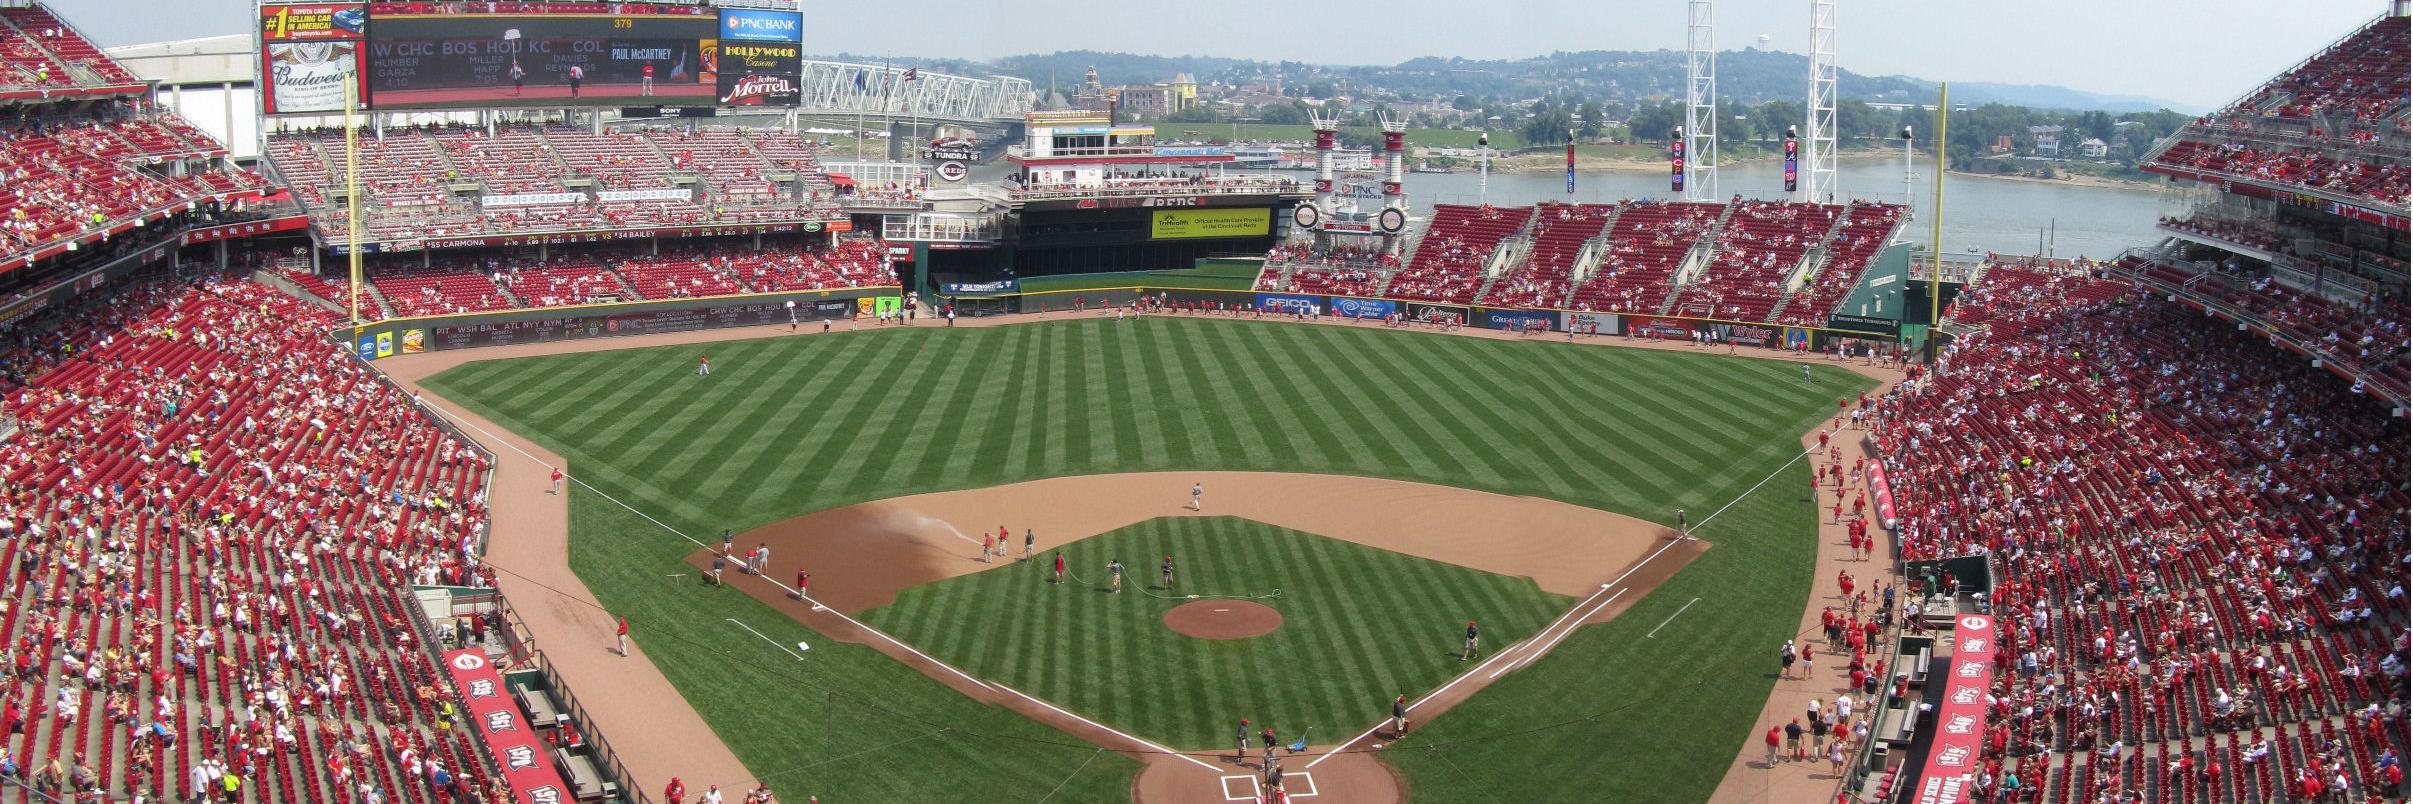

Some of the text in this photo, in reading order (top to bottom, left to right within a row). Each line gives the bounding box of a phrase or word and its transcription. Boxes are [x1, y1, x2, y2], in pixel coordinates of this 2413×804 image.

[265, 6, 288, 38] #1
[296, 22, 332, 30] AMERICA!
[614, 19, 632, 29] 379
[741, 18, 796, 30] PNC BANK
[397, 43, 434, 56] CHC
[442, 42, 478, 54] BOS
[486, 41, 522, 54] HOU
[529, 40, 550, 53] KC
[573, 40, 604, 53] COL
[725, 46, 796, 58] HOLLYWOOD
[553, 54, 589, 62] DAVIES
[612, 48, 672, 60] PAUL McCARTNEY
[374, 58, 419, 67] HUMBER
[469, 56, 504, 65] MILLER
[744, 56, 778, 67] Casino
[378, 68, 416, 77] GARZA
[474, 65, 500, 74] HAPP
[545, 63, 596, 72] REYNDS
[754, 75, 778, 84] John
[721, 80, 798, 102] Morrell
[1353, 186, 1375, 194] PNC
[426, 241, 440, 249] #55
[443, 240, 485, 248] CARMONA
[1265, 298, 1310, 308] GEICO
[619, 319, 642, 328] PNC
[1732, 325, 1772, 340] Wyler
[1955, 689, 1978, 703] 1975
[489, 712, 511, 729] 1961
[1947, 716, 1974, 732] 1940
[510, 746, 532, 766] 1970
[1940, 748, 1966, 764] 1919
[1924, 776, 1942, 796] SERIES
